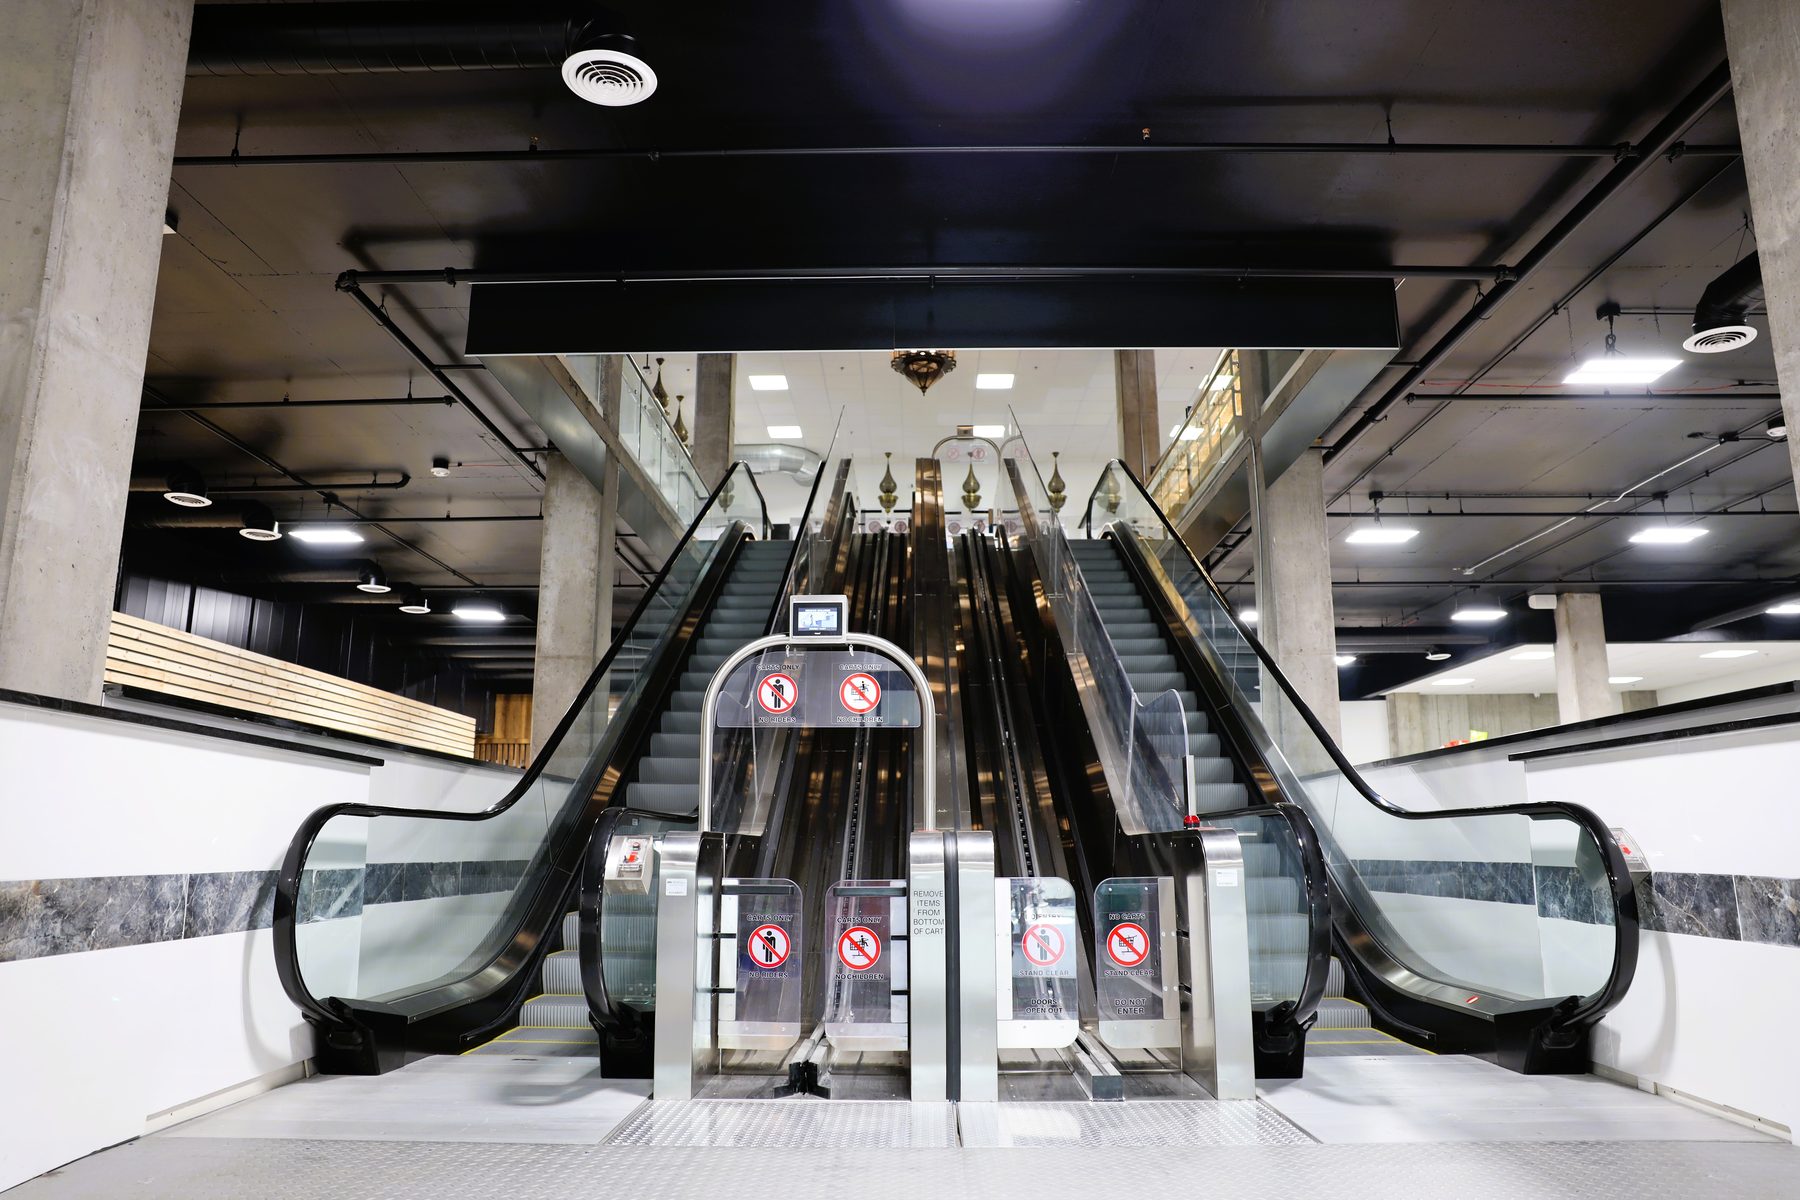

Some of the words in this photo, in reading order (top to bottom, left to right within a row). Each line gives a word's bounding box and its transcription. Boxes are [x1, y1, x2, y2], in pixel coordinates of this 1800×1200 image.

[781, 663, 800, 671] ONLY
[836, 715, 848, 723] NO
[913, 890, 944, 898] REMOVE
[916, 899, 941, 907] ITEMS
[746, 914, 772, 922] CARTS
[773, 914, 794, 922] ONLY
[836, 916, 861, 924] CARTS
[1121, 912, 1147, 920] CARTS
[913, 918, 945, 926] BOTTOM
[913, 927, 924, 935] OF
[925, 927, 944, 935] CART
[1103, 969, 1129, 977] STAND
[1031, 998, 1058, 1006] DOORS
[1114, 998, 1128, 1006] DO
[1129, 998, 1147, 1006] NOT
[1116, 1007, 1146, 1015] ENTER
